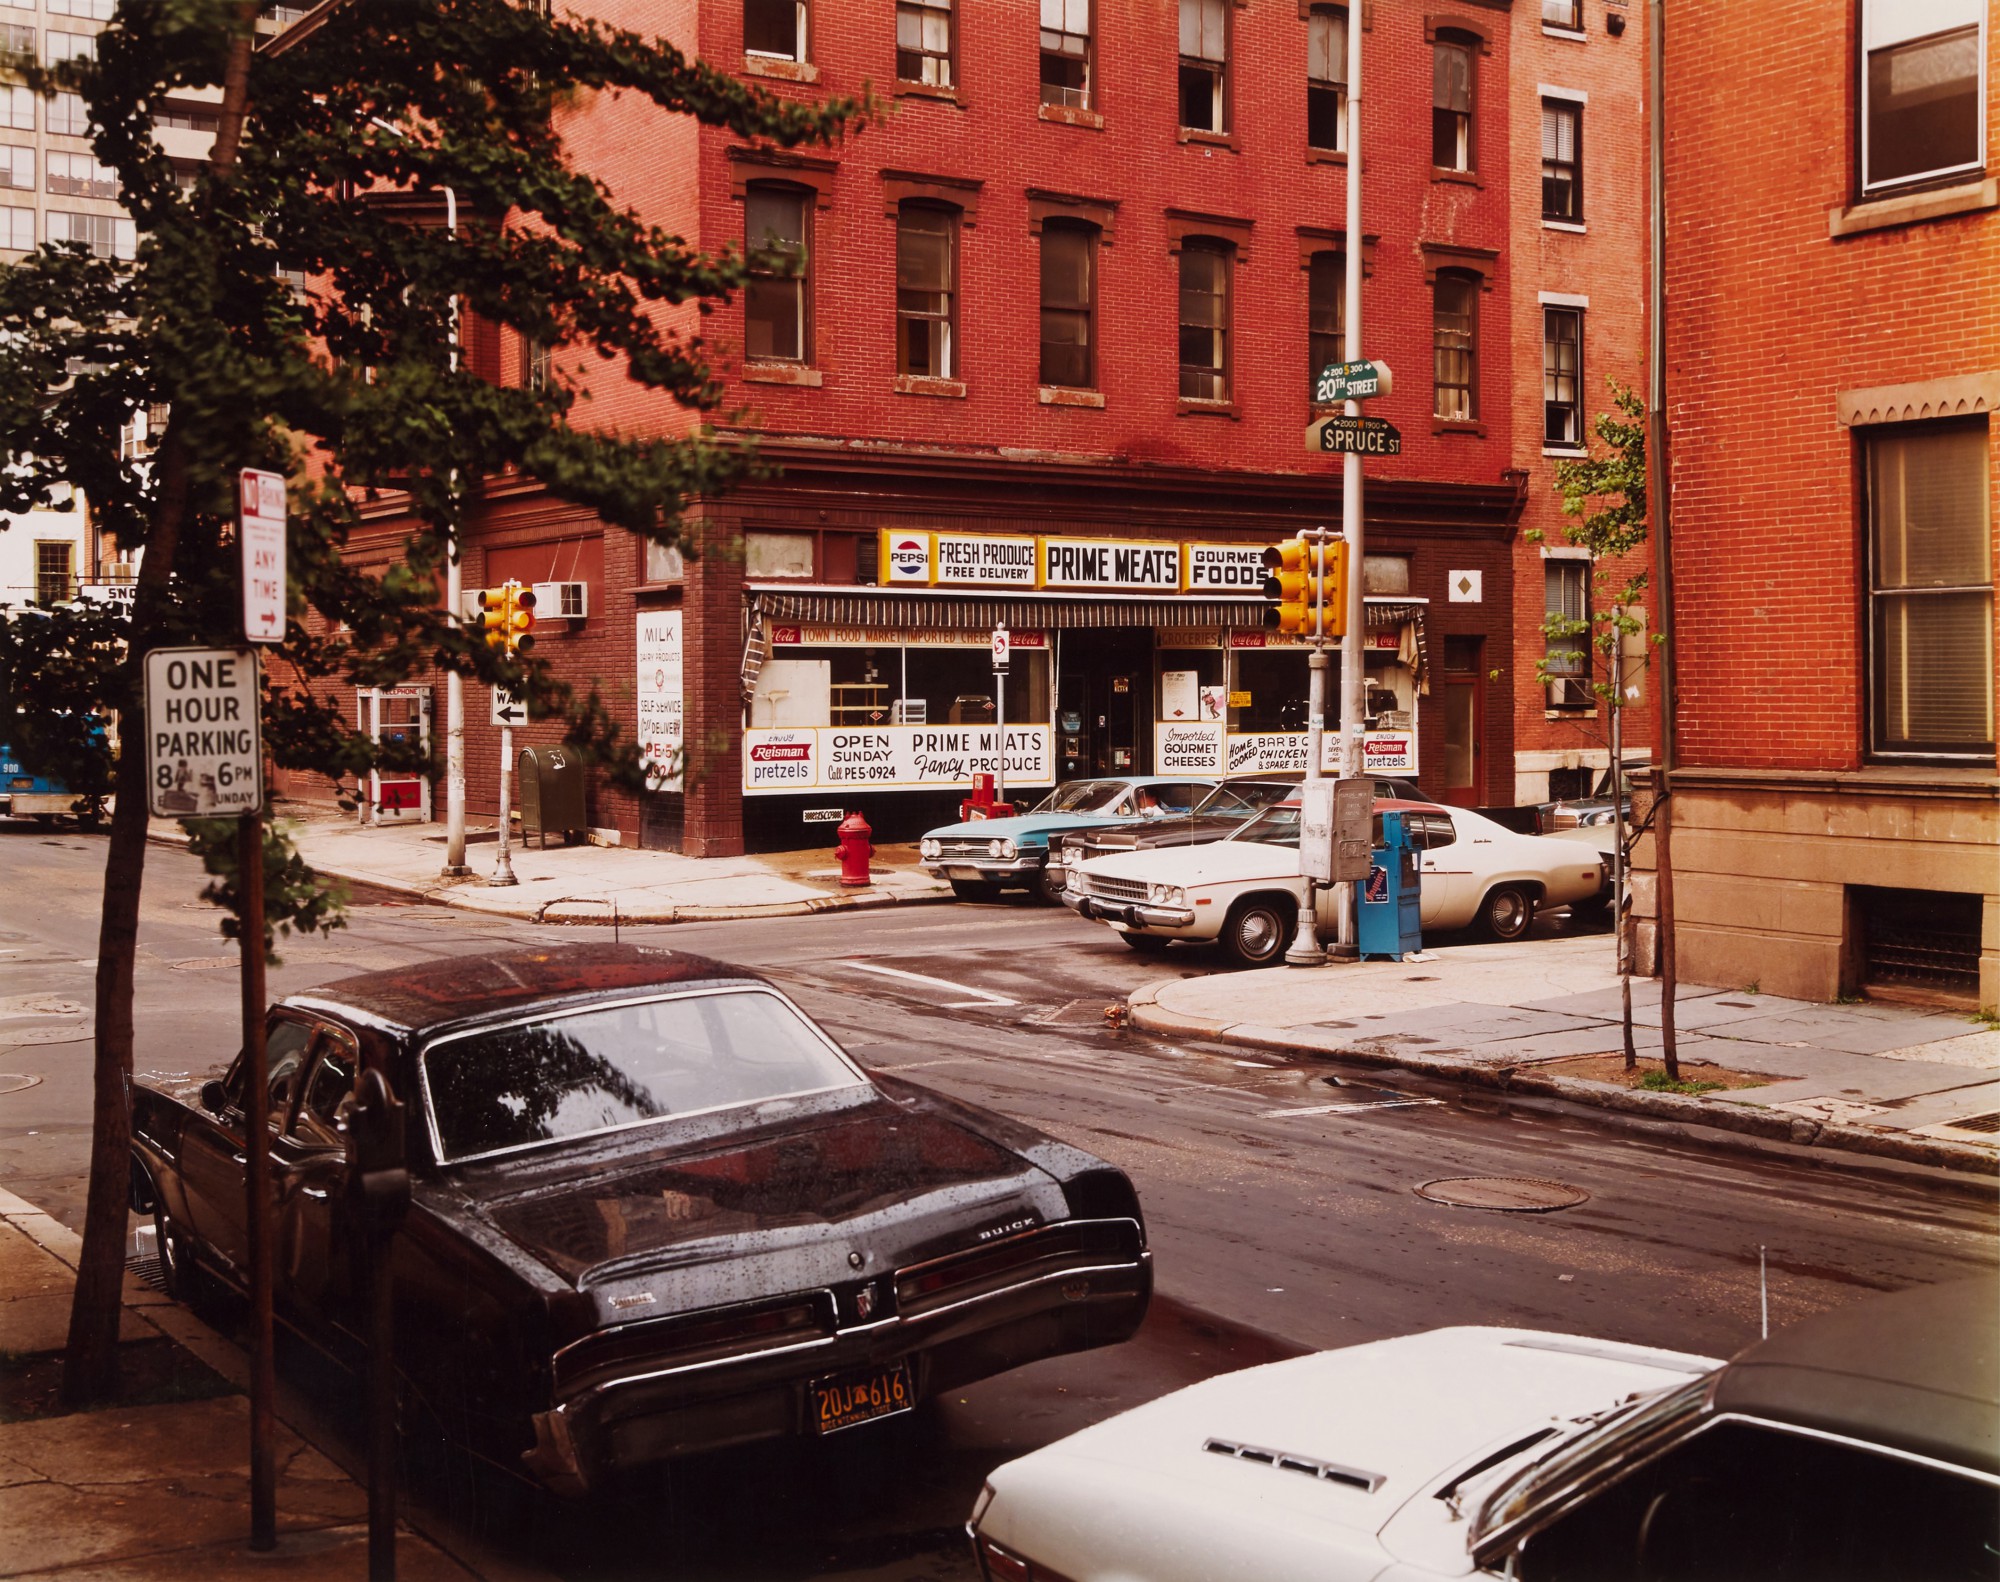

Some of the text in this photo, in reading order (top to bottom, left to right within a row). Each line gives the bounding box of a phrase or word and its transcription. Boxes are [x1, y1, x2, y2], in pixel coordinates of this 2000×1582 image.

[1330, 367, 1343, 376] 200
[1350, 364, 1363, 374] 300
[1317, 377, 1378, 401] 20TH STREET
[1340, 419, 1357, 428] 2000
[1365, 421, 1380, 430] 1900
[1325, 428, 1400, 453] SPRUCE ST
[255, 549, 277, 570] ANY
[891, 552, 928, 563] PEPSI
[939, 541, 1034, 566] FRESH PRODUCE
[1195, 550, 1265, 564] GOURMET
[945, 566, 1029, 579] FREE DELIVERY
[1047, 546, 1177, 584] PRIME MEATS
[1193, 565, 1270, 585] FOODS
[253, 578, 278, 600] TIME
[644, 626, 674, 643] MILK
[802, 628, 901, 643] TOWN FOOD MARKET
[907, 629, 992, 644] IMPORTED CHEES
[655, 652, 680, 662] PRODUCTS
[167, 659, 237, 690] ONE
[496, 692, 522, 705] WA
[640, 699, 681, 713] SELF SERVICE
[166, 696, 240, 724] HOUR
[768, 733, 794, 742] ENJOY
[833, 735, 889, 748] OPEN
[913, 733, 970, 752] PRIME
[1165, 727, 1216, 744] Imported
[156, 729, 252, 758] PARKING
[1164, 742, 1218, 754] GOURMET
[1229, 738, 1253, 759] HOME
[1367, 742, 1403, 754] Reisman
[754, 746, 804, 760] Reisman
[832, 750, 893, 762] SUNDAY
[1229, 746, 1258, 771] COOKED
[1259, 749, 1308, 759] CHICKEN
[3, 763, 19, 773] 900
[914, 754, 1041, 781] Fancy PRODUCE
[1164, 756, 1216, 767] CHEESES
[1264, 760, 1290, 770] SPARE
[1367, 755, 1406, 768] pretzels
[217, 762, 233, 787] 6
[235, 766, 252, 782] PM
[754, 761, 808, 782] pretzels
[827, 764, 843, 780] Call
[215, 791, 254, 805] UNDAY
[979, 1217, 1035, 1239] BUICK
[818, 1372, 904, 1420] 20J 616
